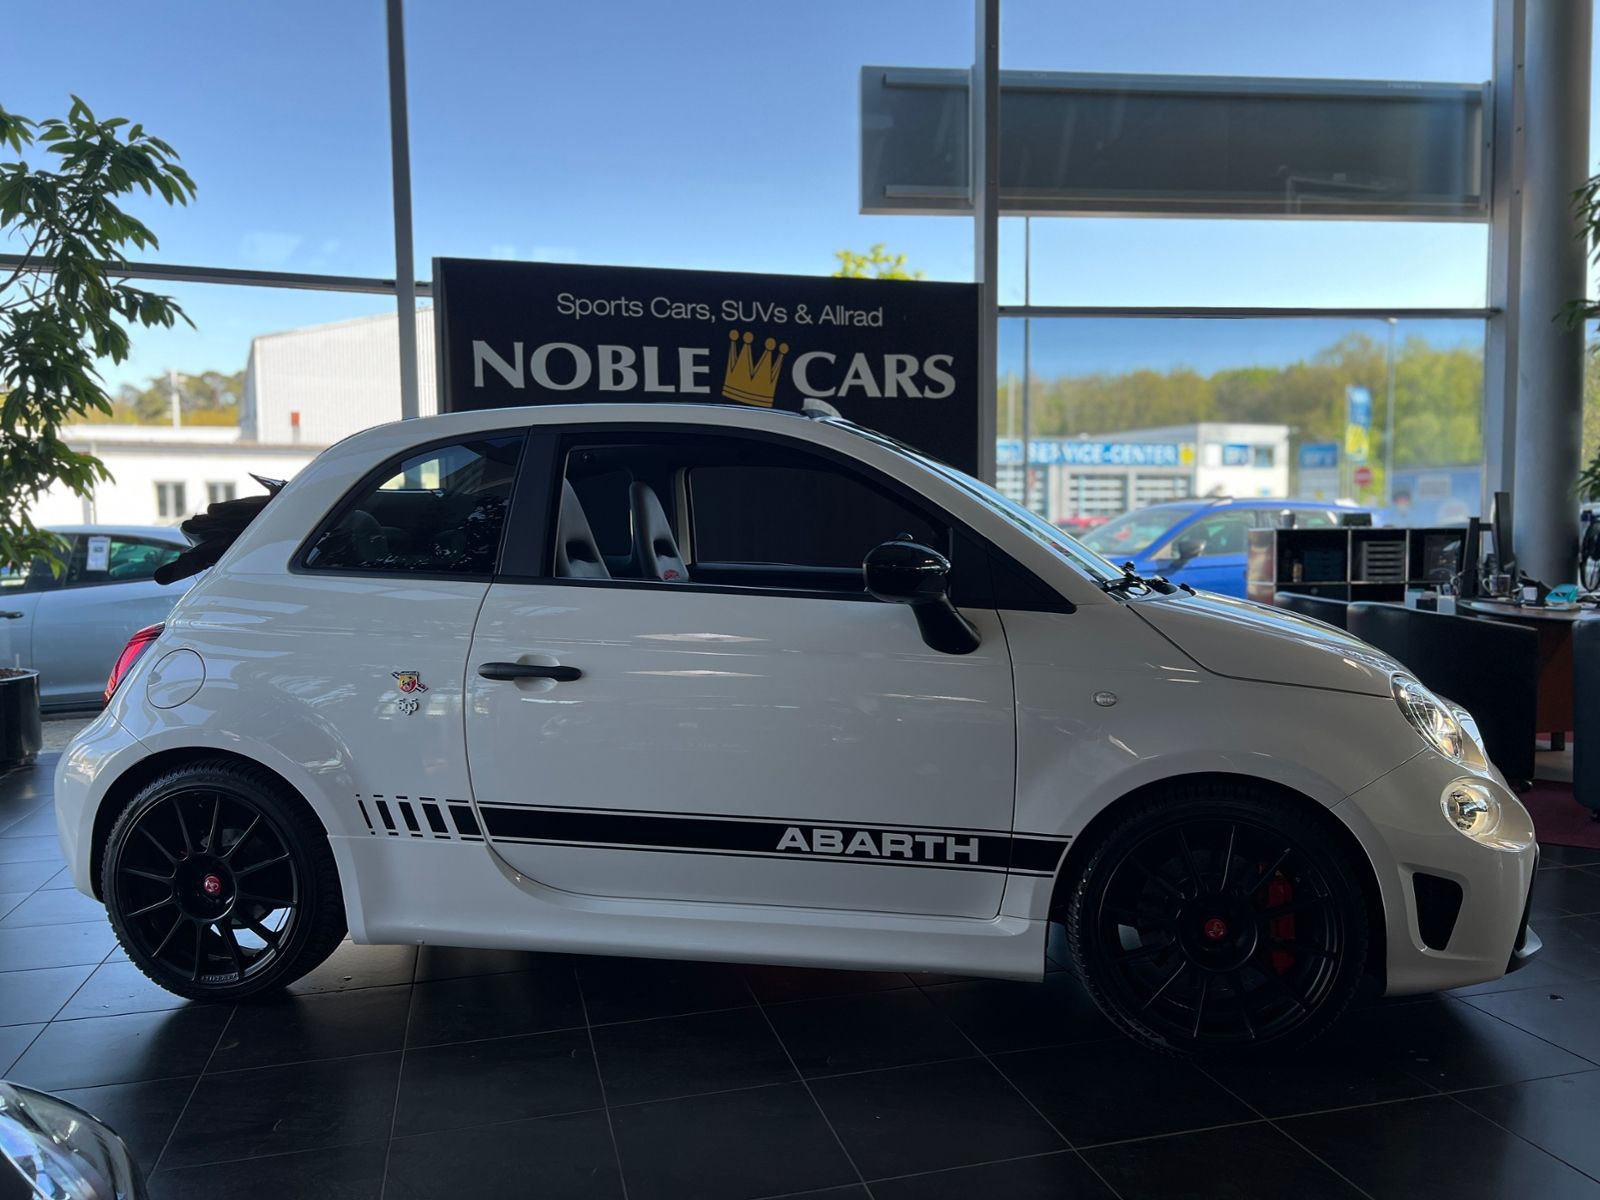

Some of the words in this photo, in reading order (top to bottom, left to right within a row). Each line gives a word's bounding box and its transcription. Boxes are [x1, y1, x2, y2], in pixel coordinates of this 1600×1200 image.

[557, 292, 644, 320] Sports
[650, 297, 716, 323] Cars,
[721, 300, 788, 323] SUVs
[794, 304, 814, 325] &
[818, 304, 883, 327] Allrad
[472, 340, 711, 393] NOBLE
[791, 351, 956, 399] CARS
[776, 827, 979, 862] ABARTH
